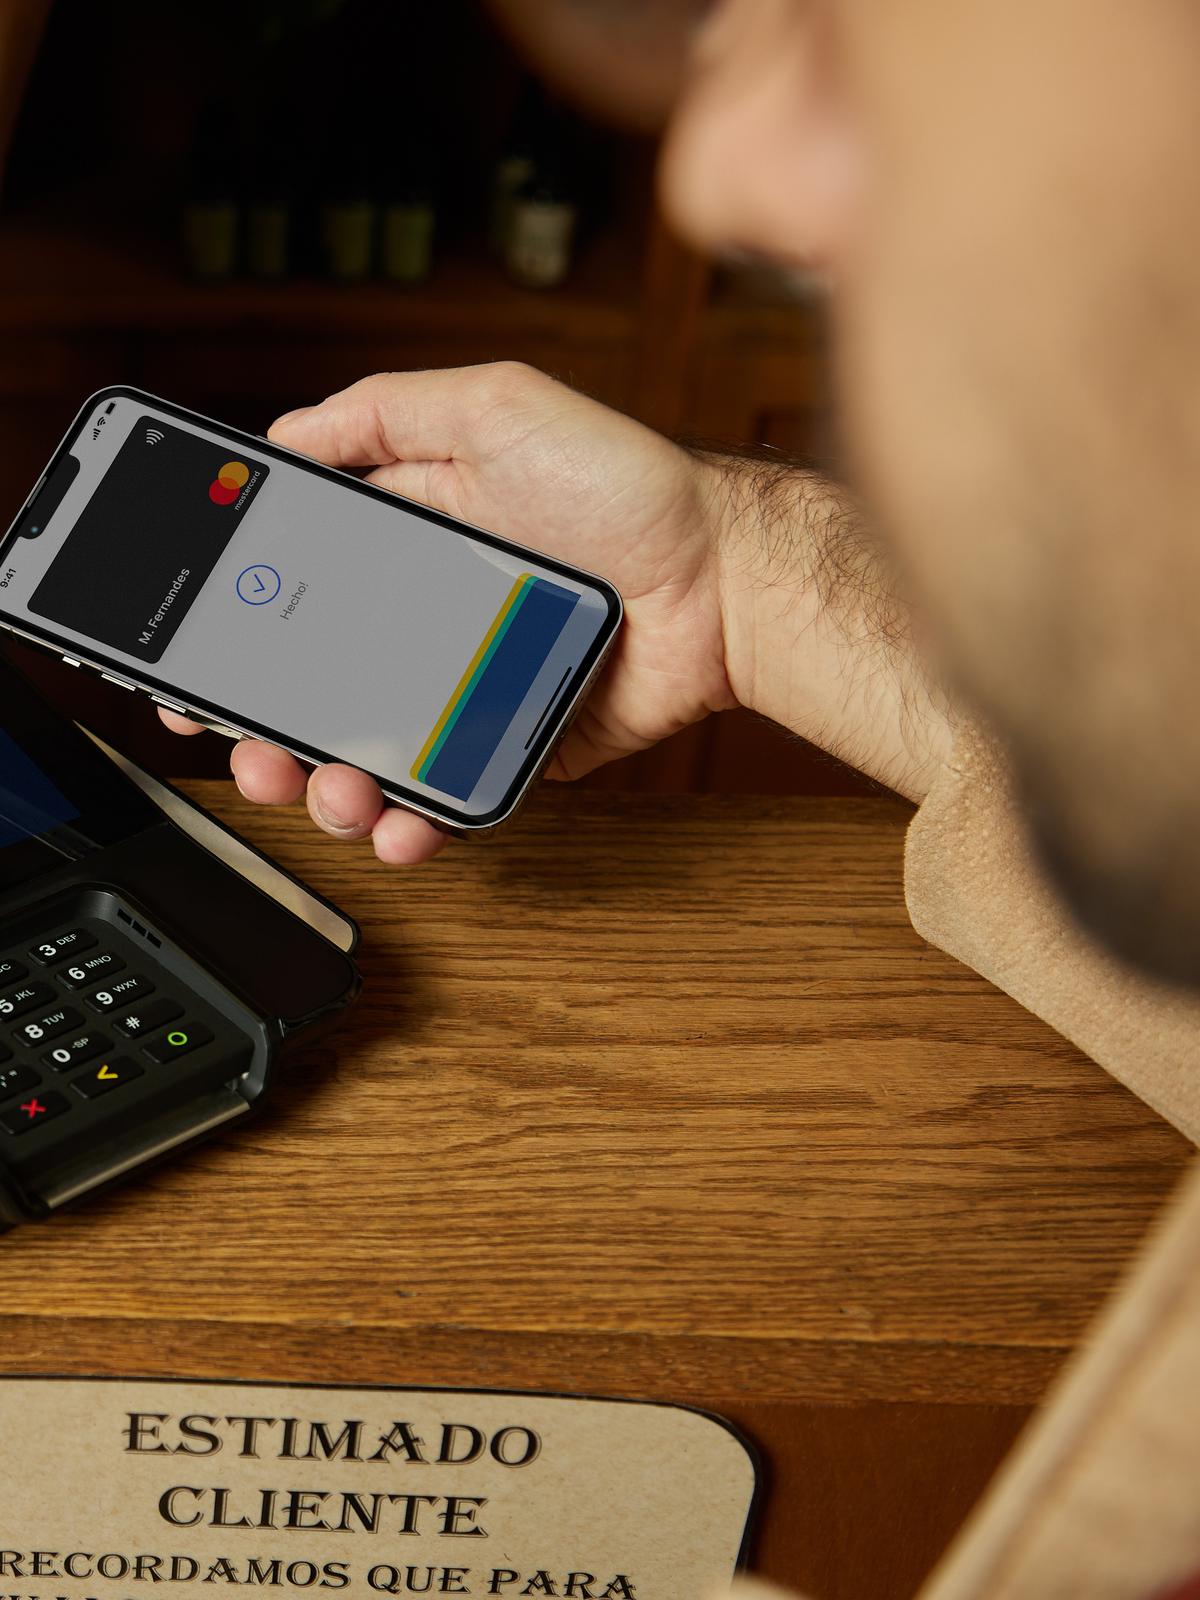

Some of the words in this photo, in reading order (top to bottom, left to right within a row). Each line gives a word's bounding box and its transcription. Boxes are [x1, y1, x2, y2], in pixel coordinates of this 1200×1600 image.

[233, 470, 262, 511] mastercard
[0, 568, 17, 589] 9:41
[138, 629, 154, 645] M.
[148, 568, 191, 628] Fernandes
[280, 581, 308, 620] Hecho!
[38, 944, 57, 957] 3
[57, 933, 78, 947] DEF
[68, 966, 86, 980] 6
[85, 954, 112, 969] MNO
[15, 989, 35, 1001] JKL
[95, 990, 114, 1005] 9
[112, 978, 138, 993] WXY
[24, 1024, 44, 1039] 8
[42, 1012, 66, 1027] TUV
[52, 1048, 71, 1063] 0
[122, 1412, 542, 1469] ESTIMADO
[158, 1485, 489, 1539] CLIENTE
[367, 1564, 472, 1595] QUE
[486, 1568, 638, 1600] PARA
